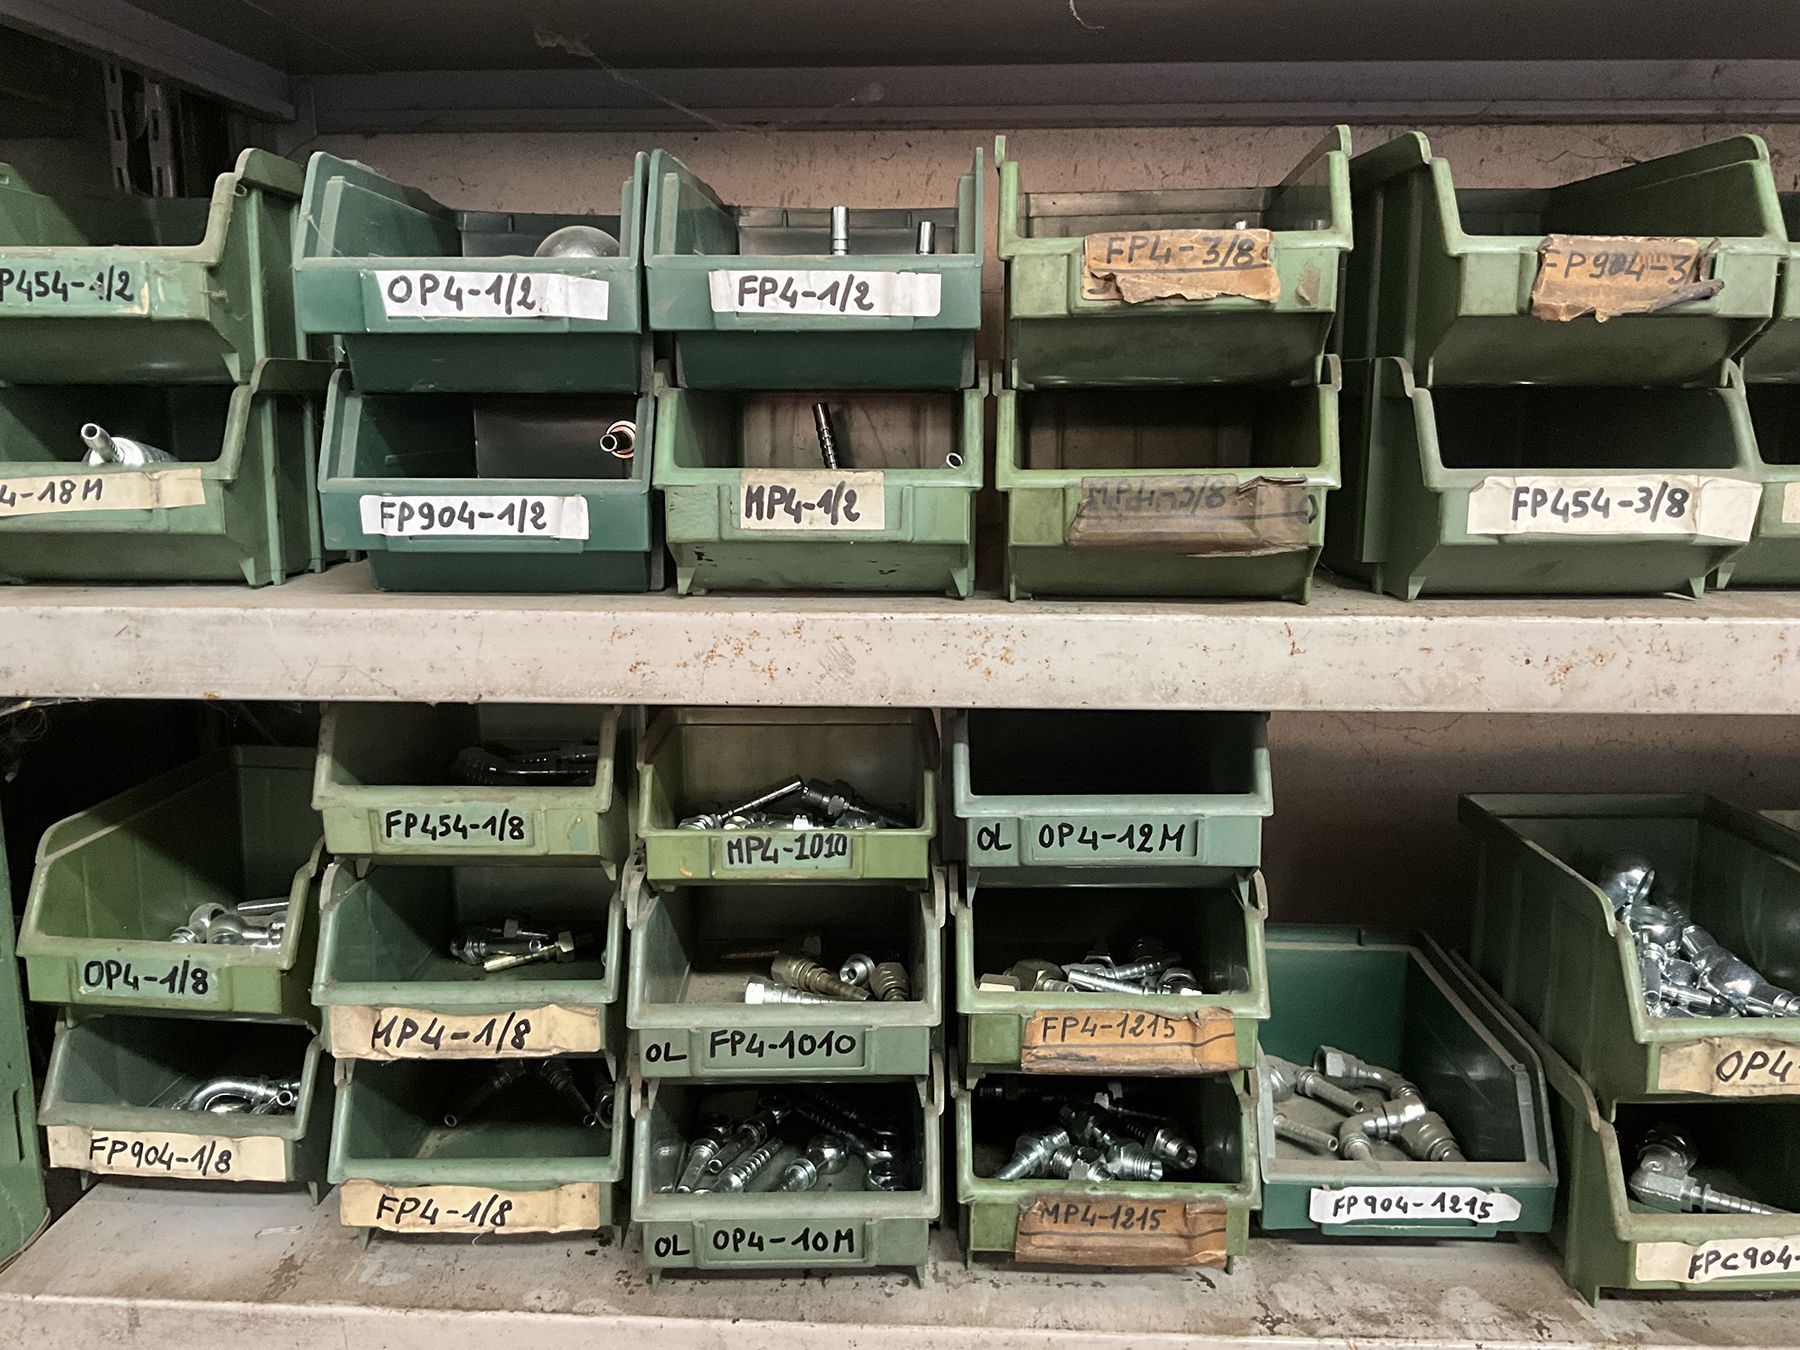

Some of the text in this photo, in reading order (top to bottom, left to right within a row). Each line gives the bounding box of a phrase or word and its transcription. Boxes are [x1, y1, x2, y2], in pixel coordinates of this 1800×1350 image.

[1106, 236, 1257, 268] FP4-3/8
[387, 275, 537, 315] OP4-1/2
[738, 275, 875, 311] FP4-1/2
[0, 478, 103, 507] 4-18M
[745, 480, 861, 525] MP4-1/2
[1511, 481, 1690, 523] FP454-3/8
[379, 501, 547, 532] FP904-1/2
[385, 808, 525, 842] FP454-1/8
[977, 823, 1185, 854] OL OP4-12M
[727, 832, 847, 864] MP4-1010
[83, 959, 208, 994] OP4-1/8
[371, 1011, 530, 1051] MP4-1/8
[1041, 1013, 1175, 1042] FP4-1215
[645, 1029, 856, 1061] OL FP4-1010
[1717, 1048, 1800, 1084] OP4
[89, 1136, 231, 1174] FP904-1/8
[376, 1194, 513, 1227] FP4-1/8
[1041, 1205, 1166, 1231] MP4-1215
[1332, 1190, 1494, 1220] FP904-1215
[654, 1227, 855, 1258] OL OP4-10M
